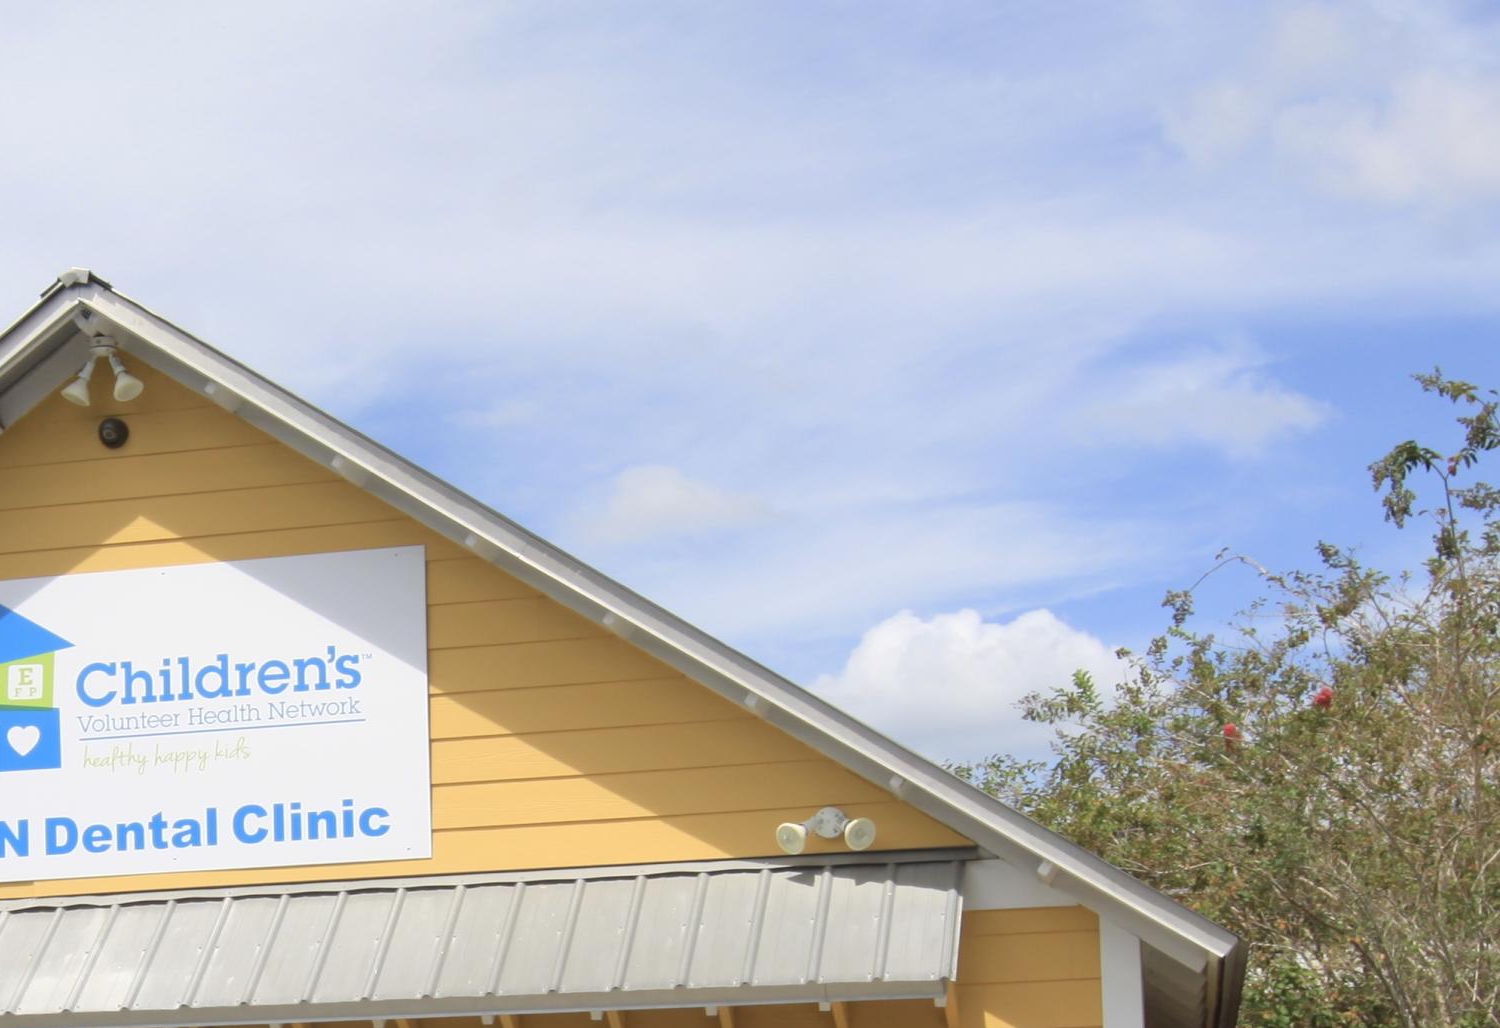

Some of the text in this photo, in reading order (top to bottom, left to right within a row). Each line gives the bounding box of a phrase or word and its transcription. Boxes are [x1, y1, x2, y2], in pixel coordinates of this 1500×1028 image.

[14, 686, 37, 698] F P
[18, 667, 33, 686] E
[76, 645, 362, 707] Children's
[77, 698, 362, 735] Volunteer Health Network
[83, 738, 251, 774] healthy happy kids
[45, 807, 218, 855] Dental
[232, 799, 390, 846] Clinic
